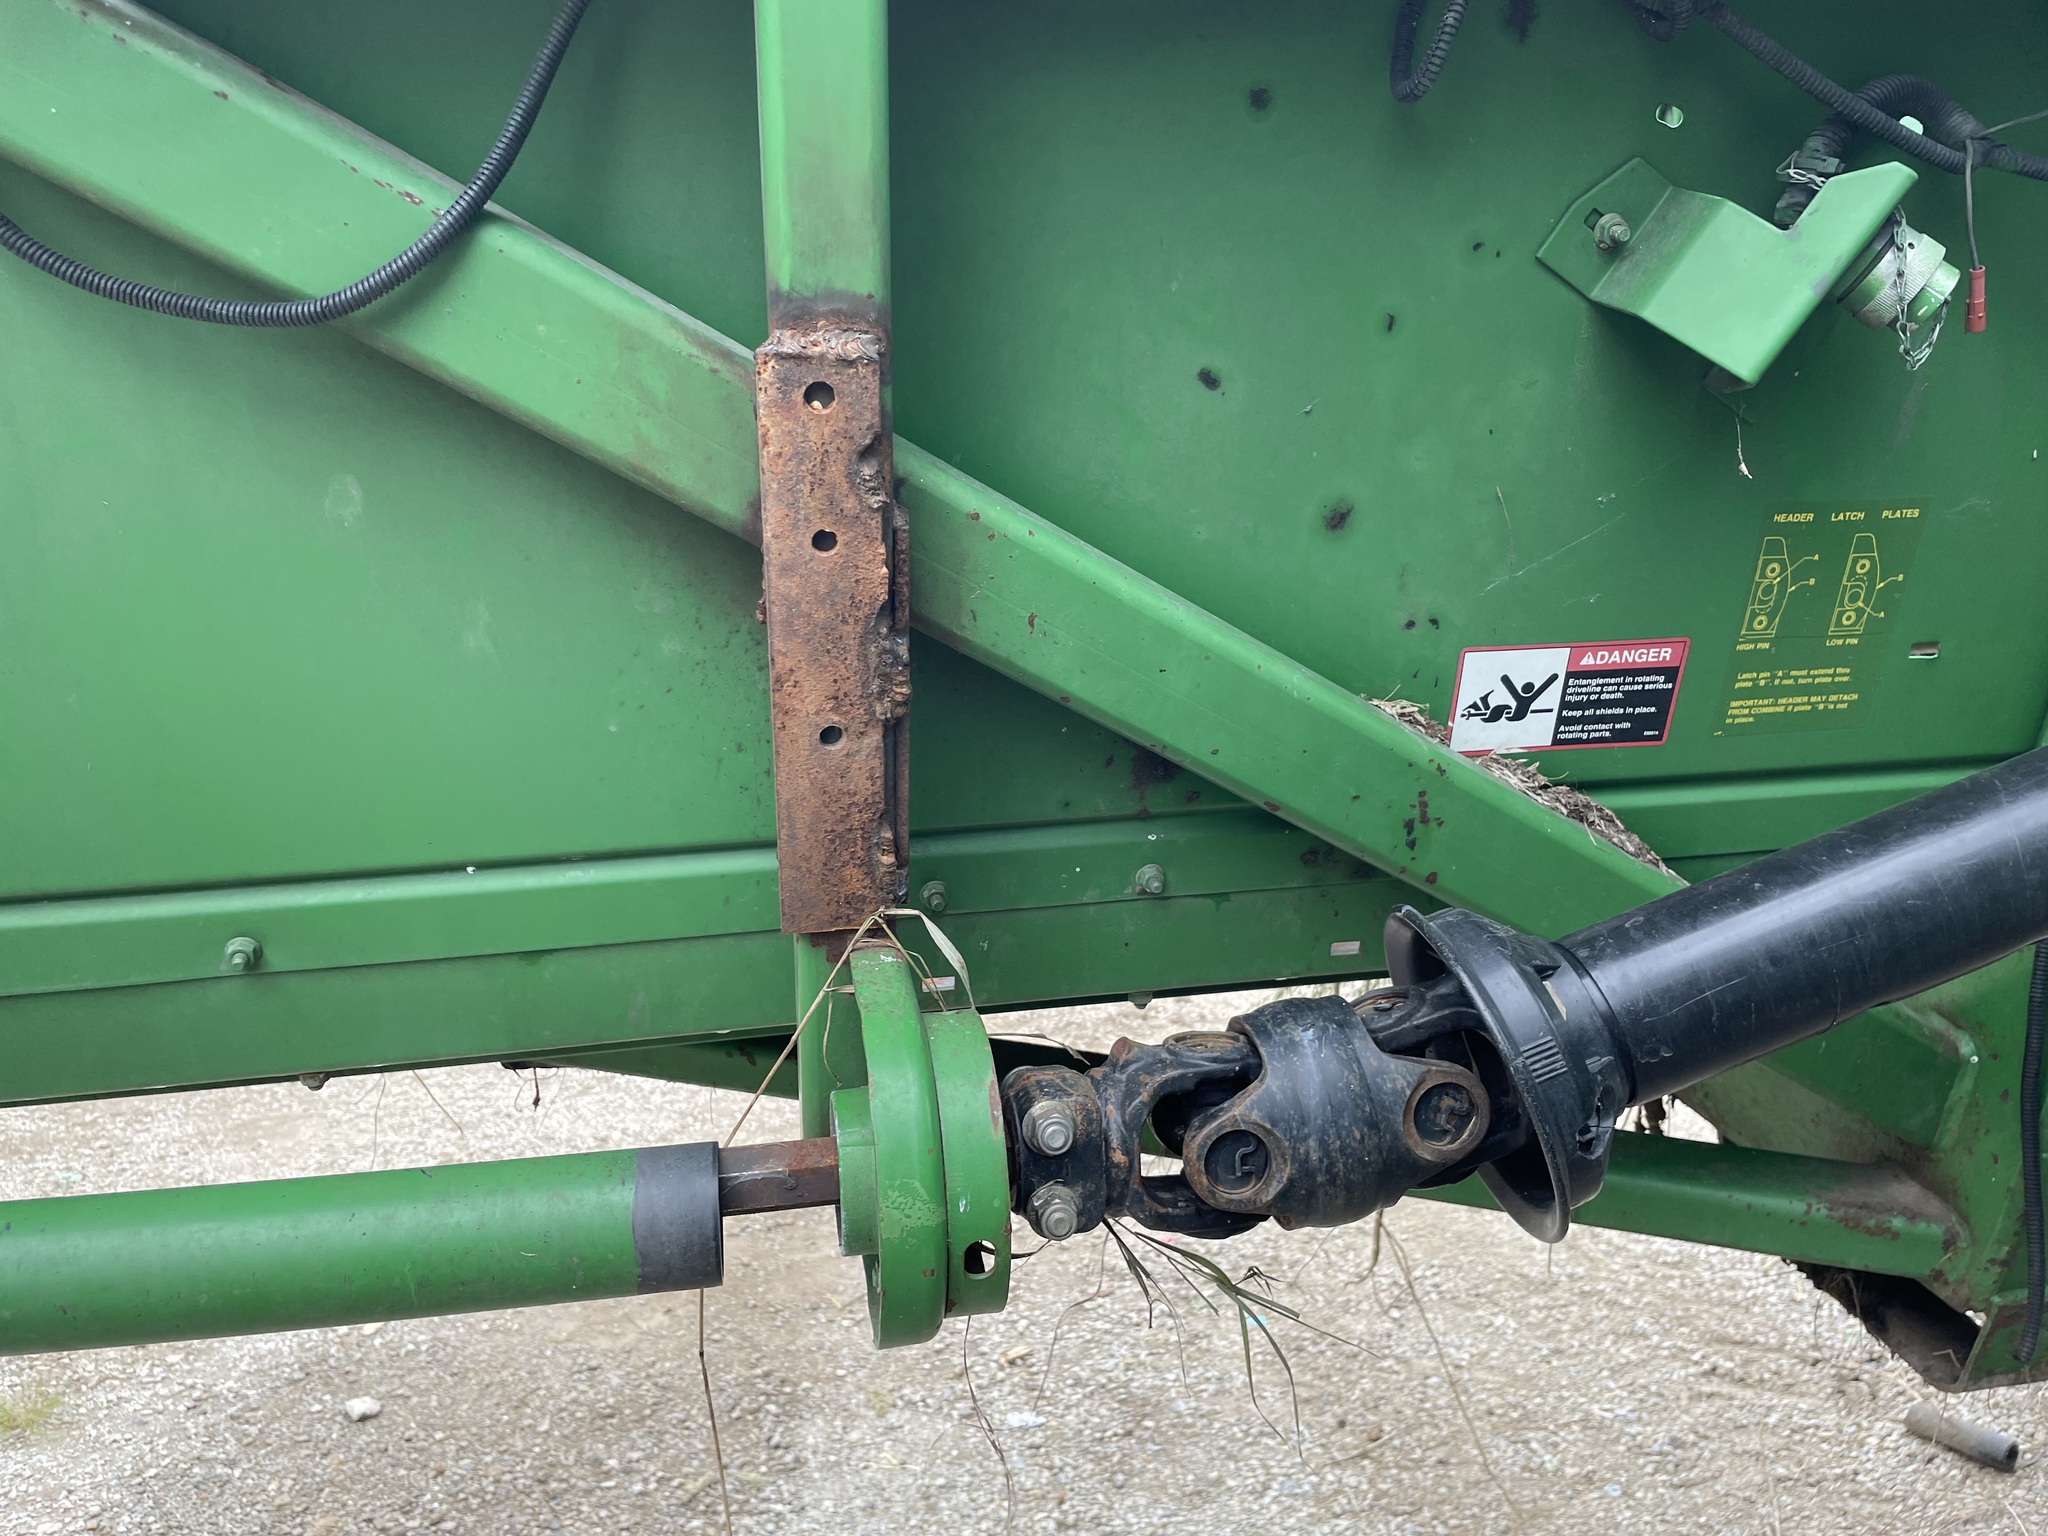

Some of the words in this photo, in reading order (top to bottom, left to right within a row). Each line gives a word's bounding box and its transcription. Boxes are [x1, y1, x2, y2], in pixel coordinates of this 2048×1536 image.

[1773, 513, 1815, 523] HEADER
[1830, 511, 1866, 522] LATCH
[1881, 508, 1920, 519] PLATES
[1736, 643, 1755, 651] HIGH
[1756, 642, 1770, 650] PIN
[1825, 639, 1844, 647] LOW
[1595, 648, 1672, 665] DANGER
[1758, 671, 1771, 679] pin
[1809, 667, 1834, 675] extend
[1568, 676, 1623, 686] Entanglement
[1634, 674, 1665, 684] rotating
[1734, 681, 1753, 689] plate
[1814, 676, 1833, 684] plate
[1566, 685, 1601, 694] driveline
[1644, 682, 1673, 690] serious
[1565, 694, 1588, 703] injury
[1600, 692, 1625, 700] death.
[1729, 698, 1776, 707] IMPORTANT:
[1777, 696, 1809, 705] HEADER
[1810, 695, 1827, 703] MAY
[1828, 693, 1859, 702] DETACH
[1561, 709, 1583, 718] Keep
[1584, 708, 1594, 716] all
[1595, 707, 1624, 715] shields
[1634, 706, 1657, 715] place.
[1727, 707, 1750, 716] FROM
[1751, 705, 1786, 715] COMBINE
[1793, 704, 1812, 713] plate
[1558, 724, 1582, 732] Avoid
[1583, 723, 1613, 731] contact
[1557, 731, 1588, 740] rotating
[1589, 730, 1612, 739] parts.
